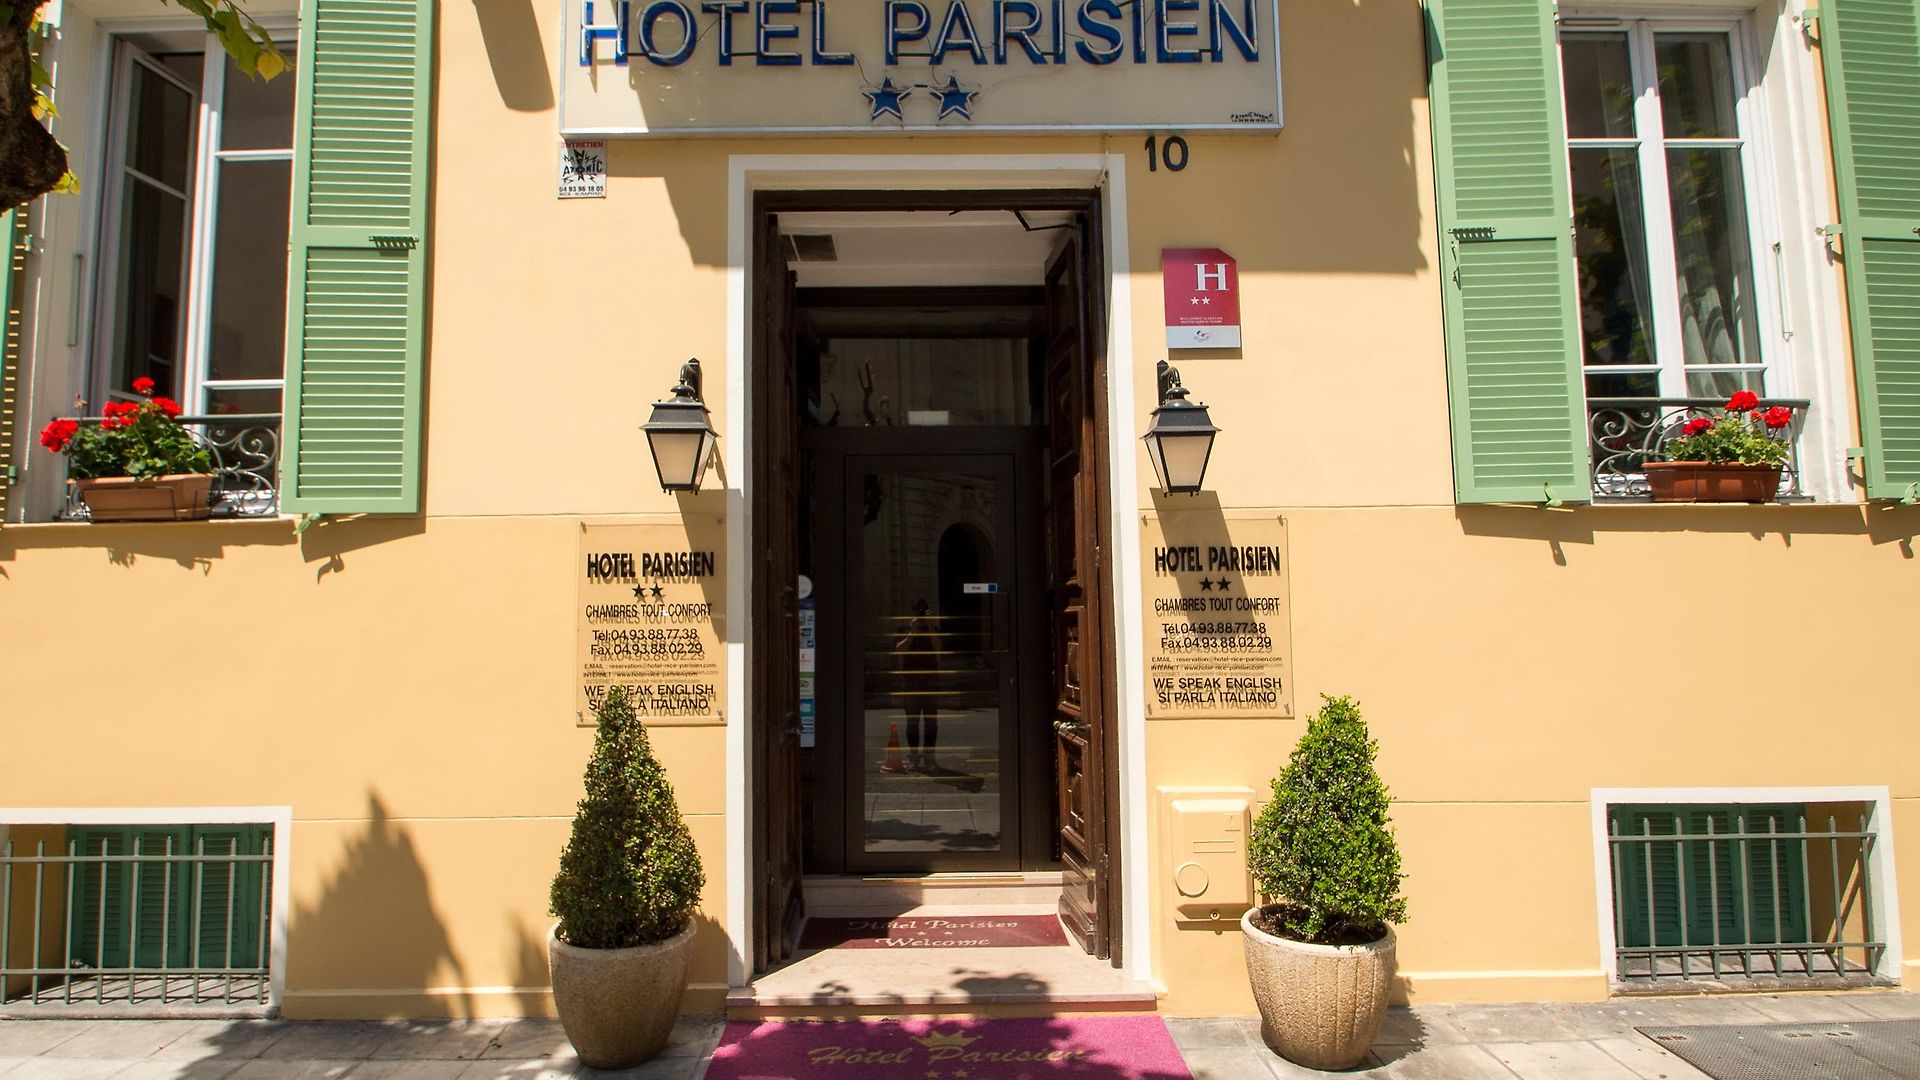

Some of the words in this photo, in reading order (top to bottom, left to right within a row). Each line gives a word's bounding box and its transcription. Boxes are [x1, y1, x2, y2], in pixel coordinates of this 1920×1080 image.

[579, 0, 855, 66] HOTEL
[885, 0, 1259, 65] PARISIEN
[1144, 135, 1189, 172] 10
[1193, 263, 1230, 291] H
[587, 552, 636, 578] HOTEL
[642, 551, 715, 577] PARISIEN
[1154, 546, 1203, 572] HOTEL
[1208, 545, 1281, 571] PARISIEN
[585, 604, 638, 618] CHAMBRES
[641, 604, 665, 618] TOUT
[669, 603, 713, 617] CONFORT
[1154, 598, 1206, 612] CHAMBRES
[1210, 597, 1233, 611] TOUT
[1236, 597, 1280, 611] CONFORT
[1161, 636, 1272, 648] Fax.04.93.88.02.29
[584, 685, 605, 696] WE
[658, 684, 714, 695] ENGLISH
[1153, 678, 1174, 689] WE
[1178, 677, 1222, 689] SPEAK
[1226, 677, 1282, 689] ENGLISH
[588, 700, 600, 710] SI
[651, 699, 709, 710] ITALIANO
[1158, 692, 1170, 703] SI
[1174, 692, 1216, 703] PARLA
[1219, 691, 1277, 703] ITALIANO
[924, 919, 1018, 929] Parisien
[875, 937, 992, 947] Welcome
[807, 1045, 913, 1065] Hôtel
[928, 1045, 1086, 1065] Parisien
